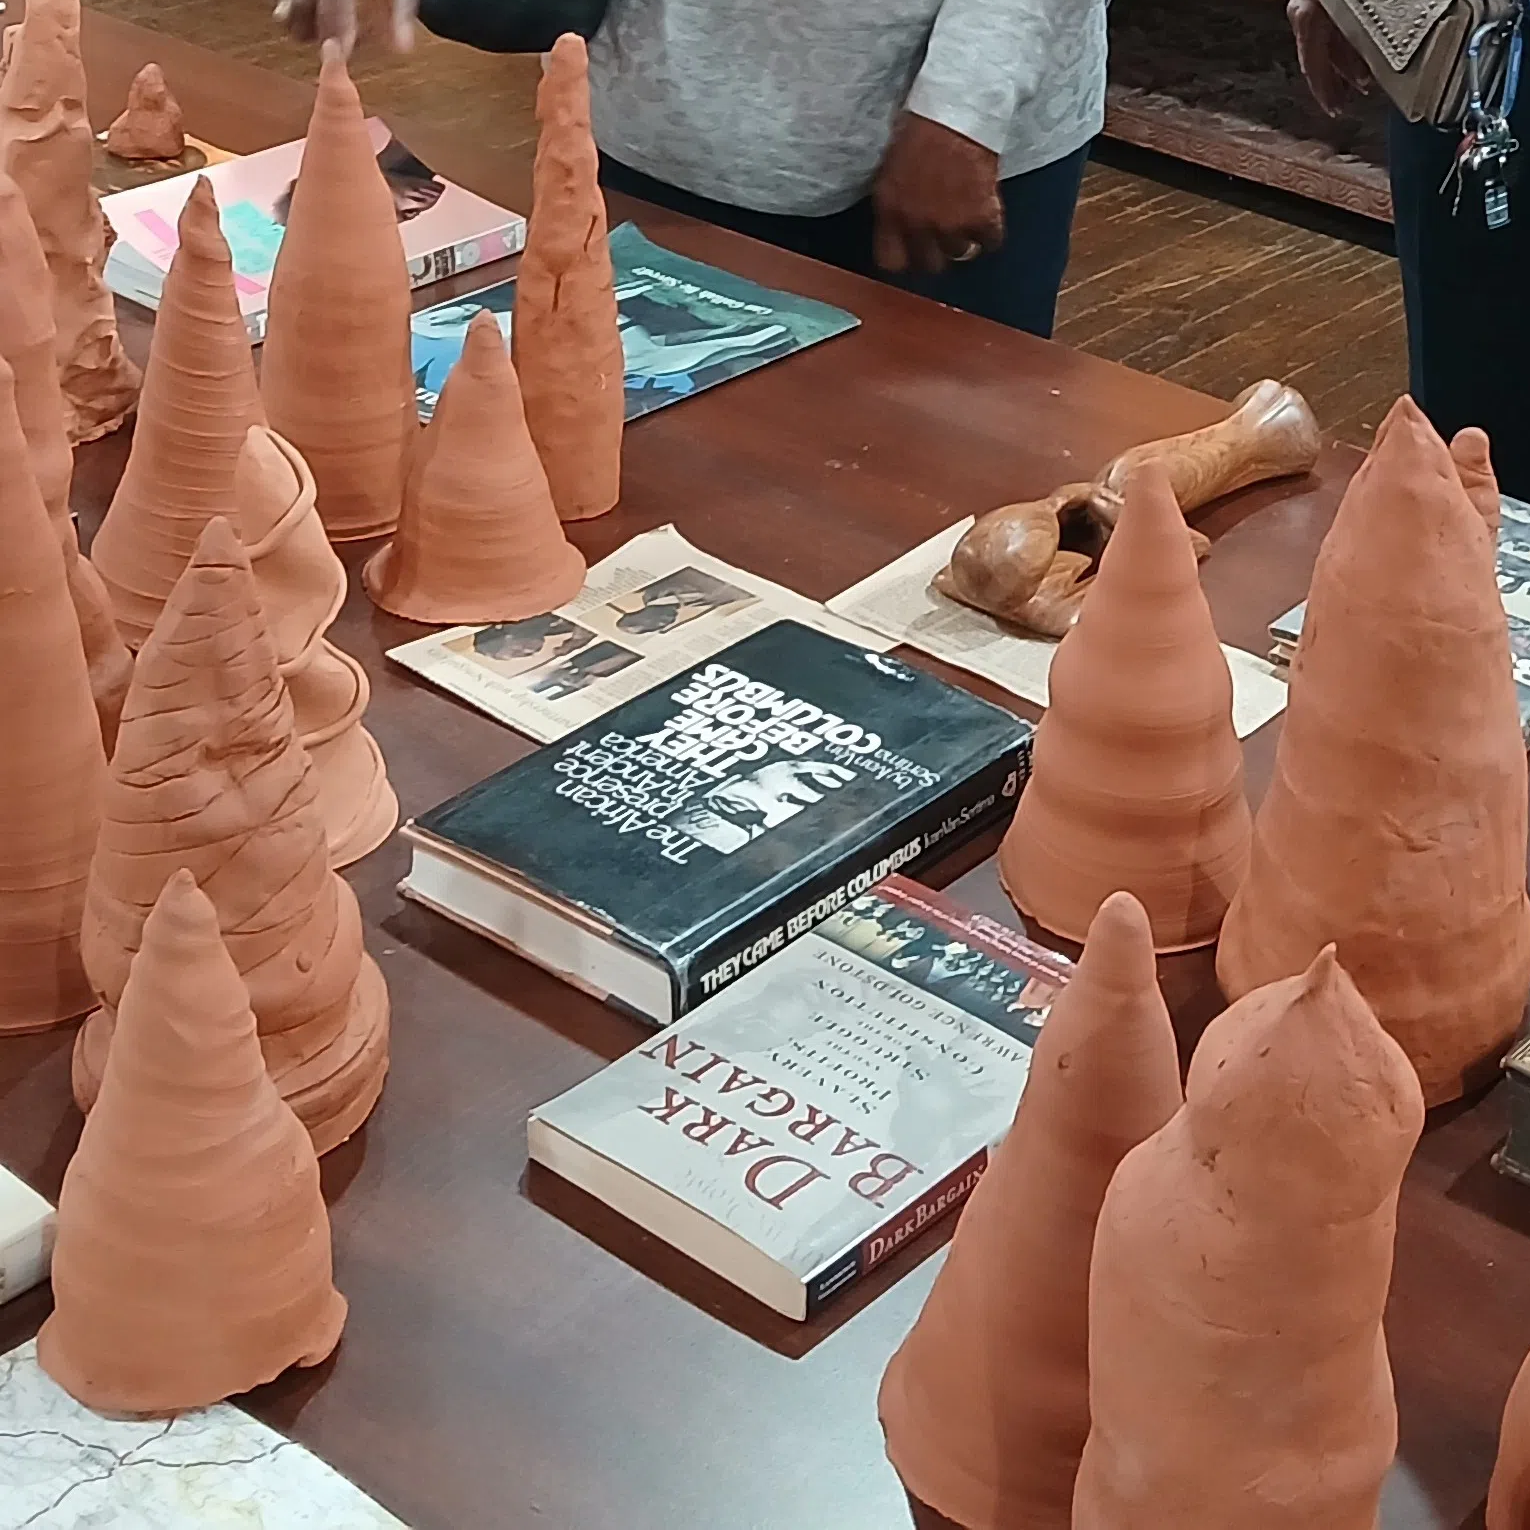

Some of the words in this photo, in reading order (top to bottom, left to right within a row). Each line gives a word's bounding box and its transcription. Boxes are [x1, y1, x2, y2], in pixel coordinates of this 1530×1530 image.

[663, 709, 769, 761] CAME
[670, 682, 825, 756] BEFORE
[691, 663, 882, 754] COLUMBUS
[562, 740, 672, 794] Ancient
[599, 731, 715, 790] America
[635, 728, 740, 779] THEY
[875, 749, 941, 787] Sertima
[553, 757, 692, 819] presence
[556, 779, 658, 834] African
[646, 823, 702, 865] The
[699, 950, 746, 995] THEY
[742, 926, 785, 969] CAME
[787, 887, 847, 939] BEFORE
[847, 835, 922, 897] COLUMBUS
[812, 949, 927, 1011] GOLDSTONE
[637, 1086, 831, 1212] DARK
[638, 1032, 925, 1210] BARGAIN
[867, 1213, 918, 1266] DARK
[914, 1162, 989, 1230] BARGAIN
